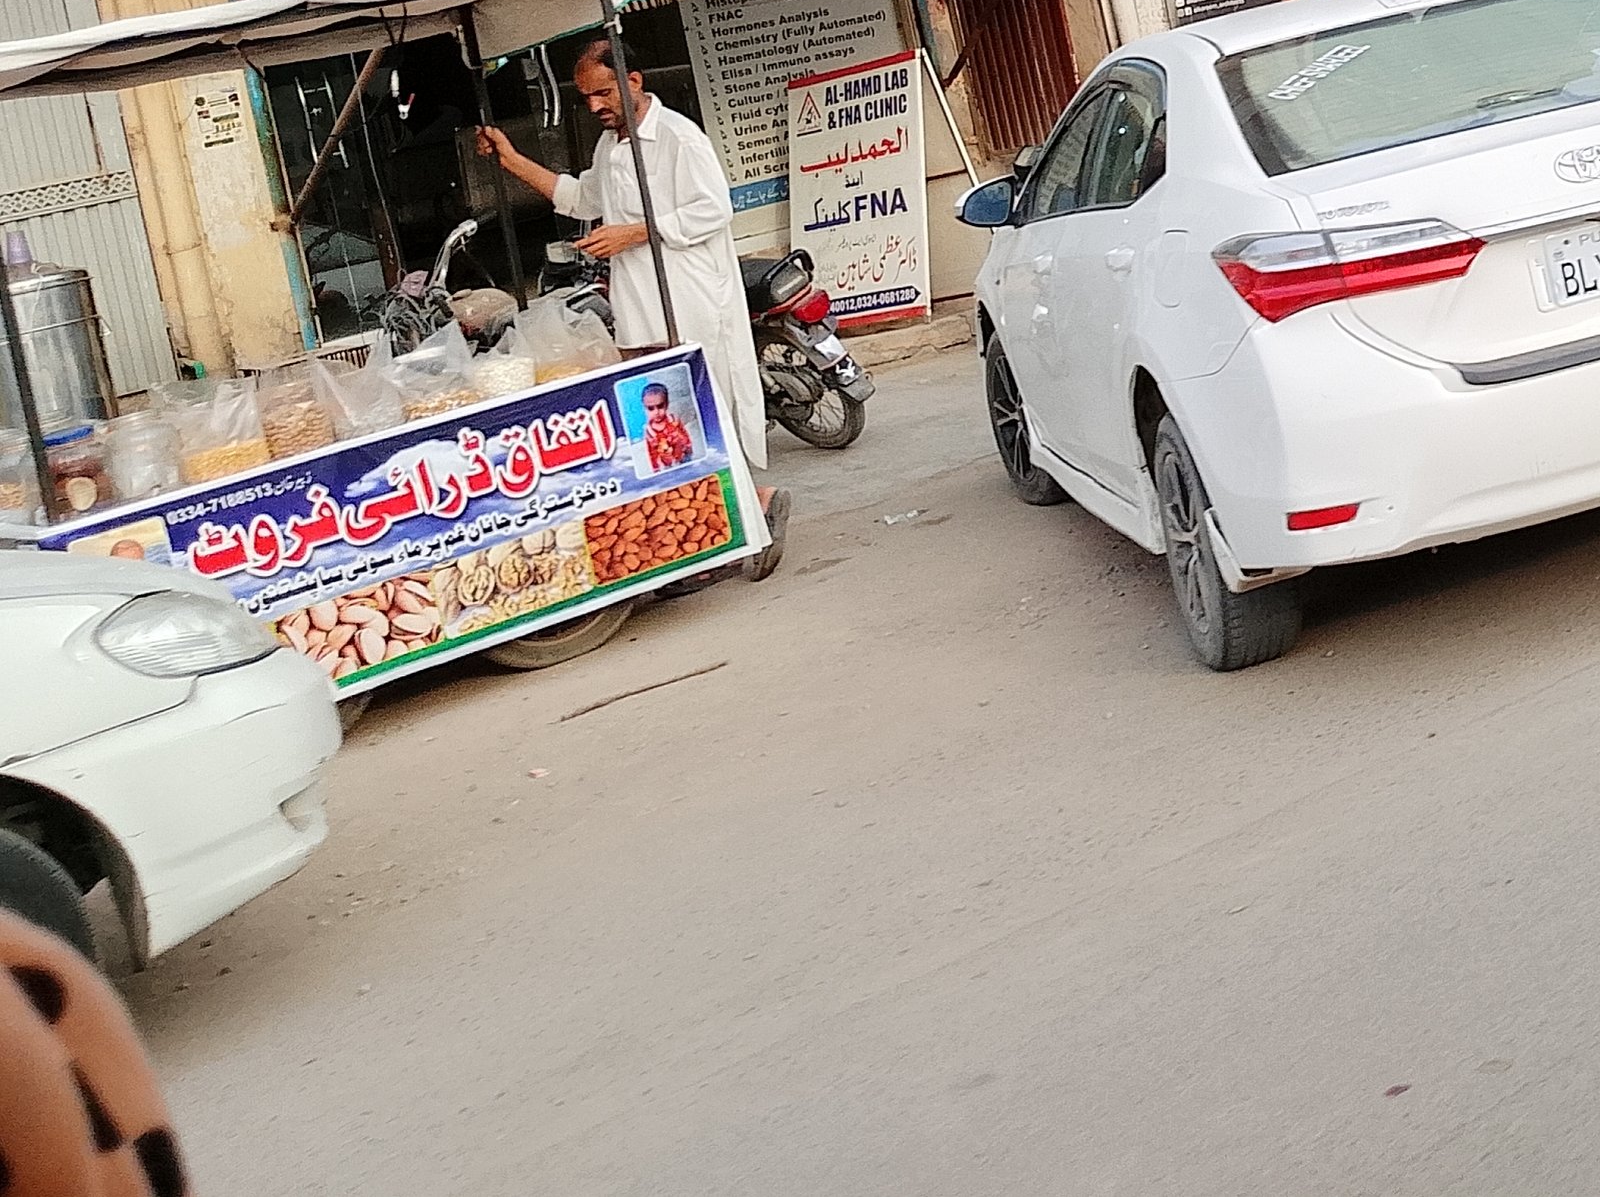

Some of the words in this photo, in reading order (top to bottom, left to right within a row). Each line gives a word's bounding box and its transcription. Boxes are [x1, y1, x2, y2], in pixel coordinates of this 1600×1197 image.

[708, 9, 744, 24] FNAC
[711, 19, 776, 38] Hormones
[779, 7, 830, 26] Analysis
[714, 33, 779, 52] Chemistry
[782, 22, 815, 41] (Fully
[818, 10, 886, 32] Automated)
[718, 42, 800, 67] Haematology
[802, 26, 876, 50] (Automated)
[721, 66, 752, 81] Elisa
[762, 55, 811, 72] Immuno
[814, 45, 856, 62] assays
[724, 81, 761, 95] Stone
[728, 92, 774, 109] Culture
[825, 75, 882, 106] AL-HAMD
[884, 68, 909, 92] LAB
[731, 107, 762, 123] Fluid
[838, 104, 862, 128] FNA
[865, 94, 908, 121] CLINIC
[734, 122, 768, 137] Urine
[737, 135, 780, 151] Semen
[851, 126, 909, 163] الحمد
[740, 145, 789, 165] Infertilit
[800, 142, 849, 178] لیب
[744, 166, 761, 180] All
[845, 170, 864, 189] اینڈ
[803, 197, 852, 232] کلینک
[854, 187, 908, 222] FNA
[836, 253, 872, 291] شاہین
[892, 236, 917, 283] ڈاکٹر
[1561, 254, 1600, 298] BL
[827, 288, 916, 314] 40012,0324-0681288
[500, 403, 616, 497] اتفاق
[345, 431, 496, 541] ڈرائی
[190, 486, 342, 577] فروٹ
